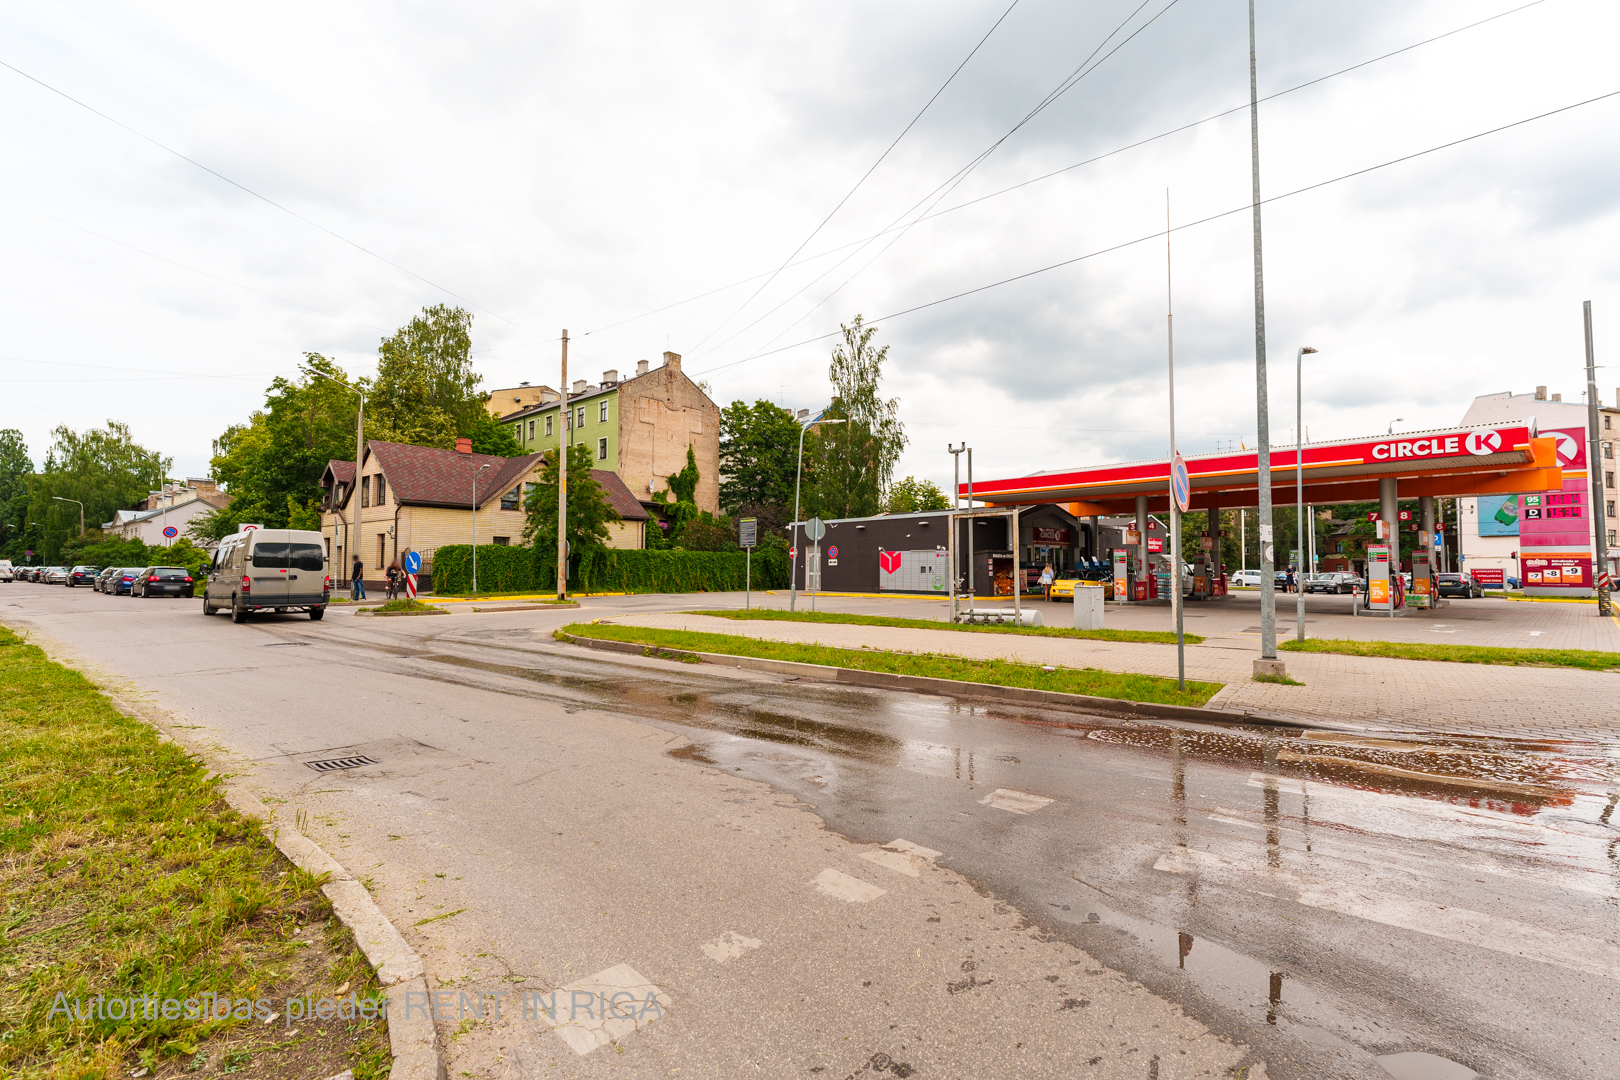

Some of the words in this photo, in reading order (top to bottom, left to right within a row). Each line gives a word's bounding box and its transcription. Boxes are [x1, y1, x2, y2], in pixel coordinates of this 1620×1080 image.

[1372, 437, 1459, 460] CIRCLE
[1474, 433, 1497, 454] K
[1400, 511, 1408, 519] 8
